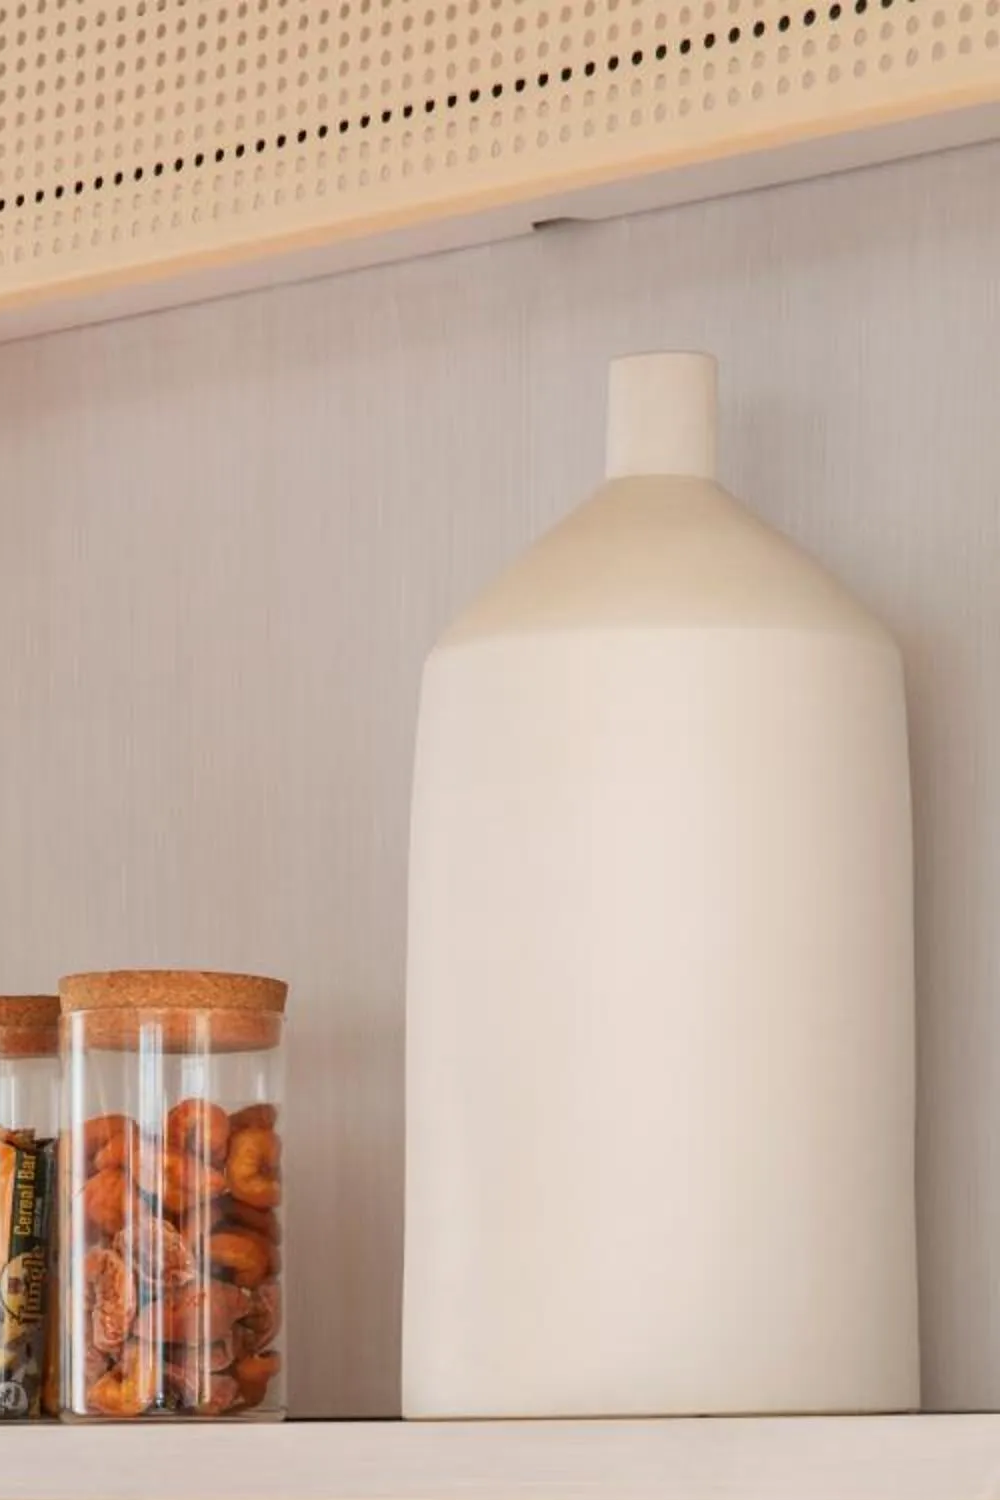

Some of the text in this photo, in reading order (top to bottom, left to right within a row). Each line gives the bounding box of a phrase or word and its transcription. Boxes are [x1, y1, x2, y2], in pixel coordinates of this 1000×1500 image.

[15, 1153, 36, 1235] Cereal Bar
[19, 1245, 48, 1323] Jungle
